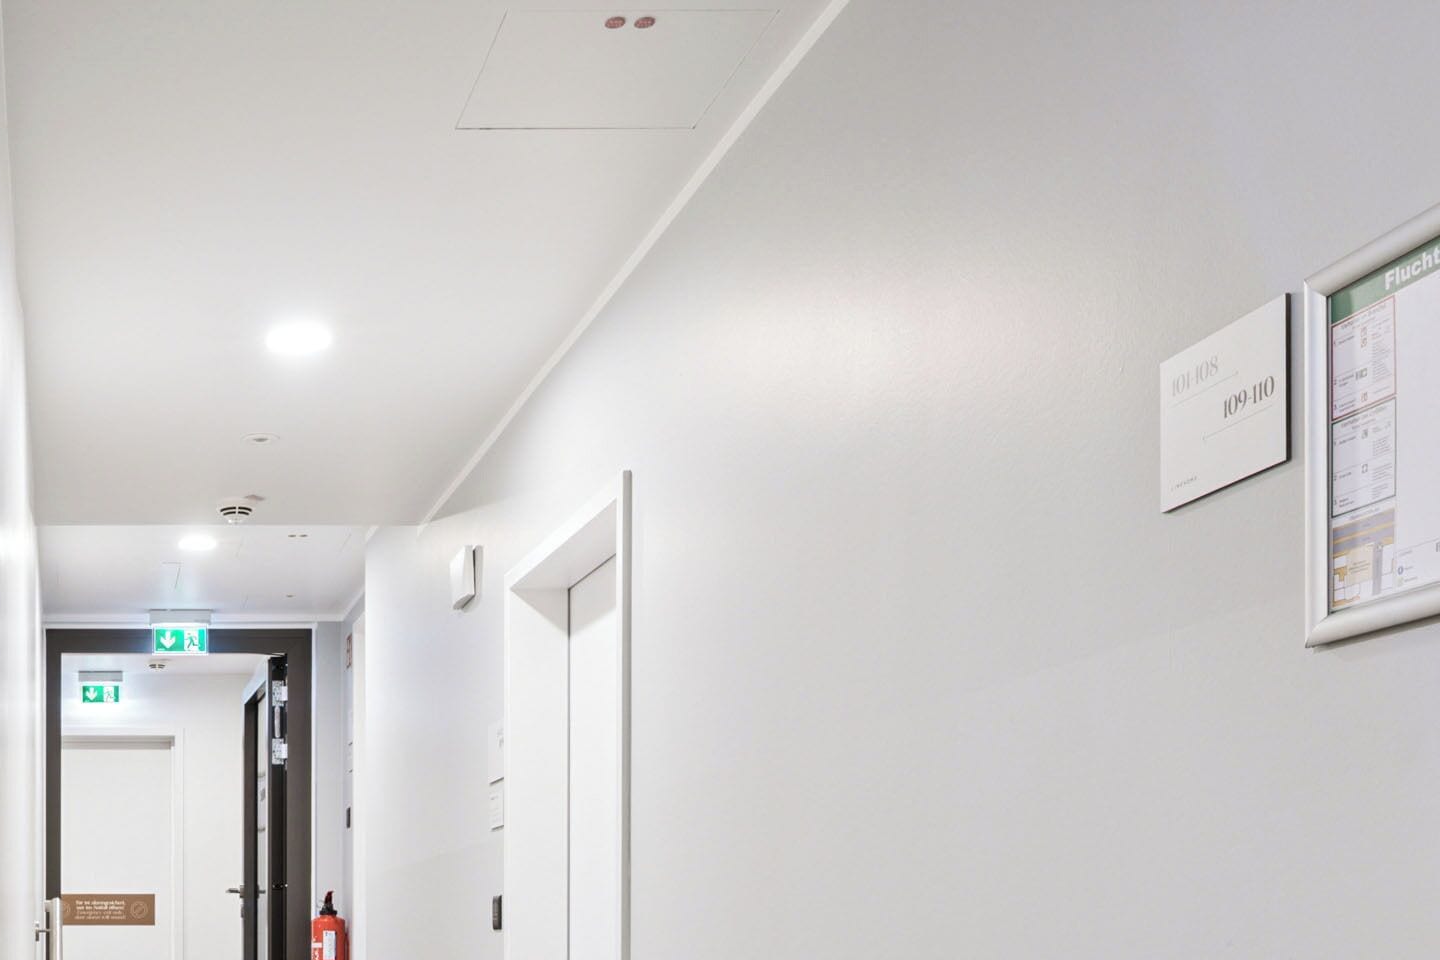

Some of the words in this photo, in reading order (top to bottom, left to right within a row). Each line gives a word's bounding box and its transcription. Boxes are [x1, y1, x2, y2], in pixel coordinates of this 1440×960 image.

[1385, 247, 1440, 290] Flucht
[1172, 356, 1218, 397] 101-108
[1224, 375, 1275, 418] 109-110
